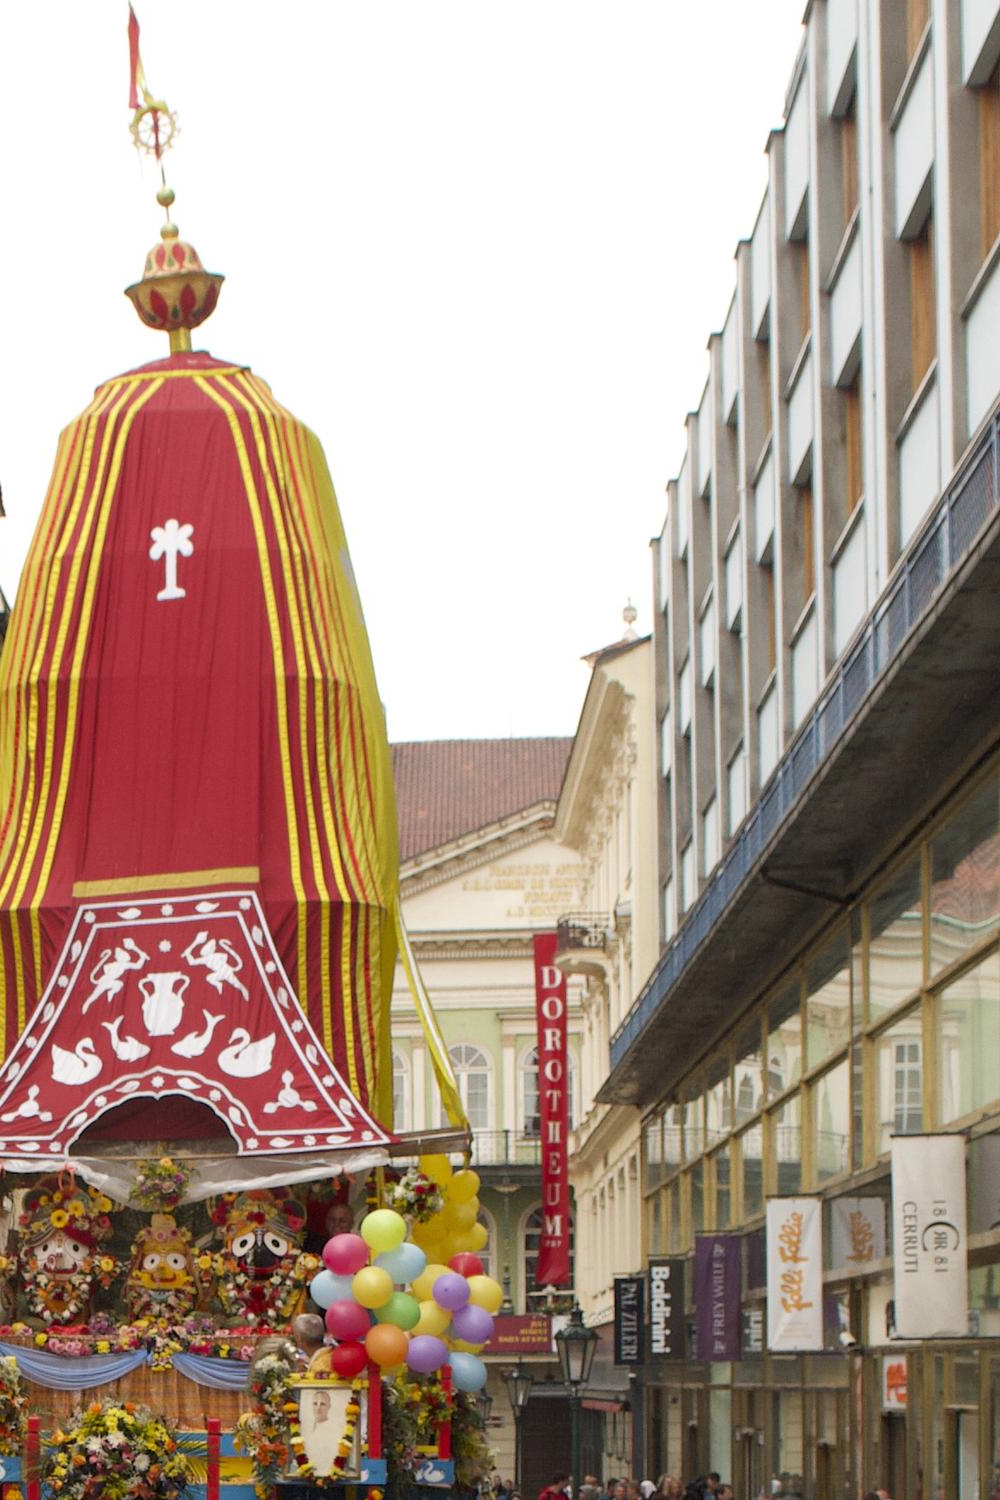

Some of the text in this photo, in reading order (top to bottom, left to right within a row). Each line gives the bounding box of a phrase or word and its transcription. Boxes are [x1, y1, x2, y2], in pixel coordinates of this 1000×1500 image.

[541, 966, 563, 1237] DOROTHEUM
[778, 1212, 809, 1264] Follie
[902, 1200, 918, 1273] CERRUTI
[620, 1282, 638, 1361] PAL ZILERI
[651, 1265, 671, 1353] Baldinini
[712, 1262, 726, 1336] FREY WILLE
[780, 1269, 814, 1313] Folli
